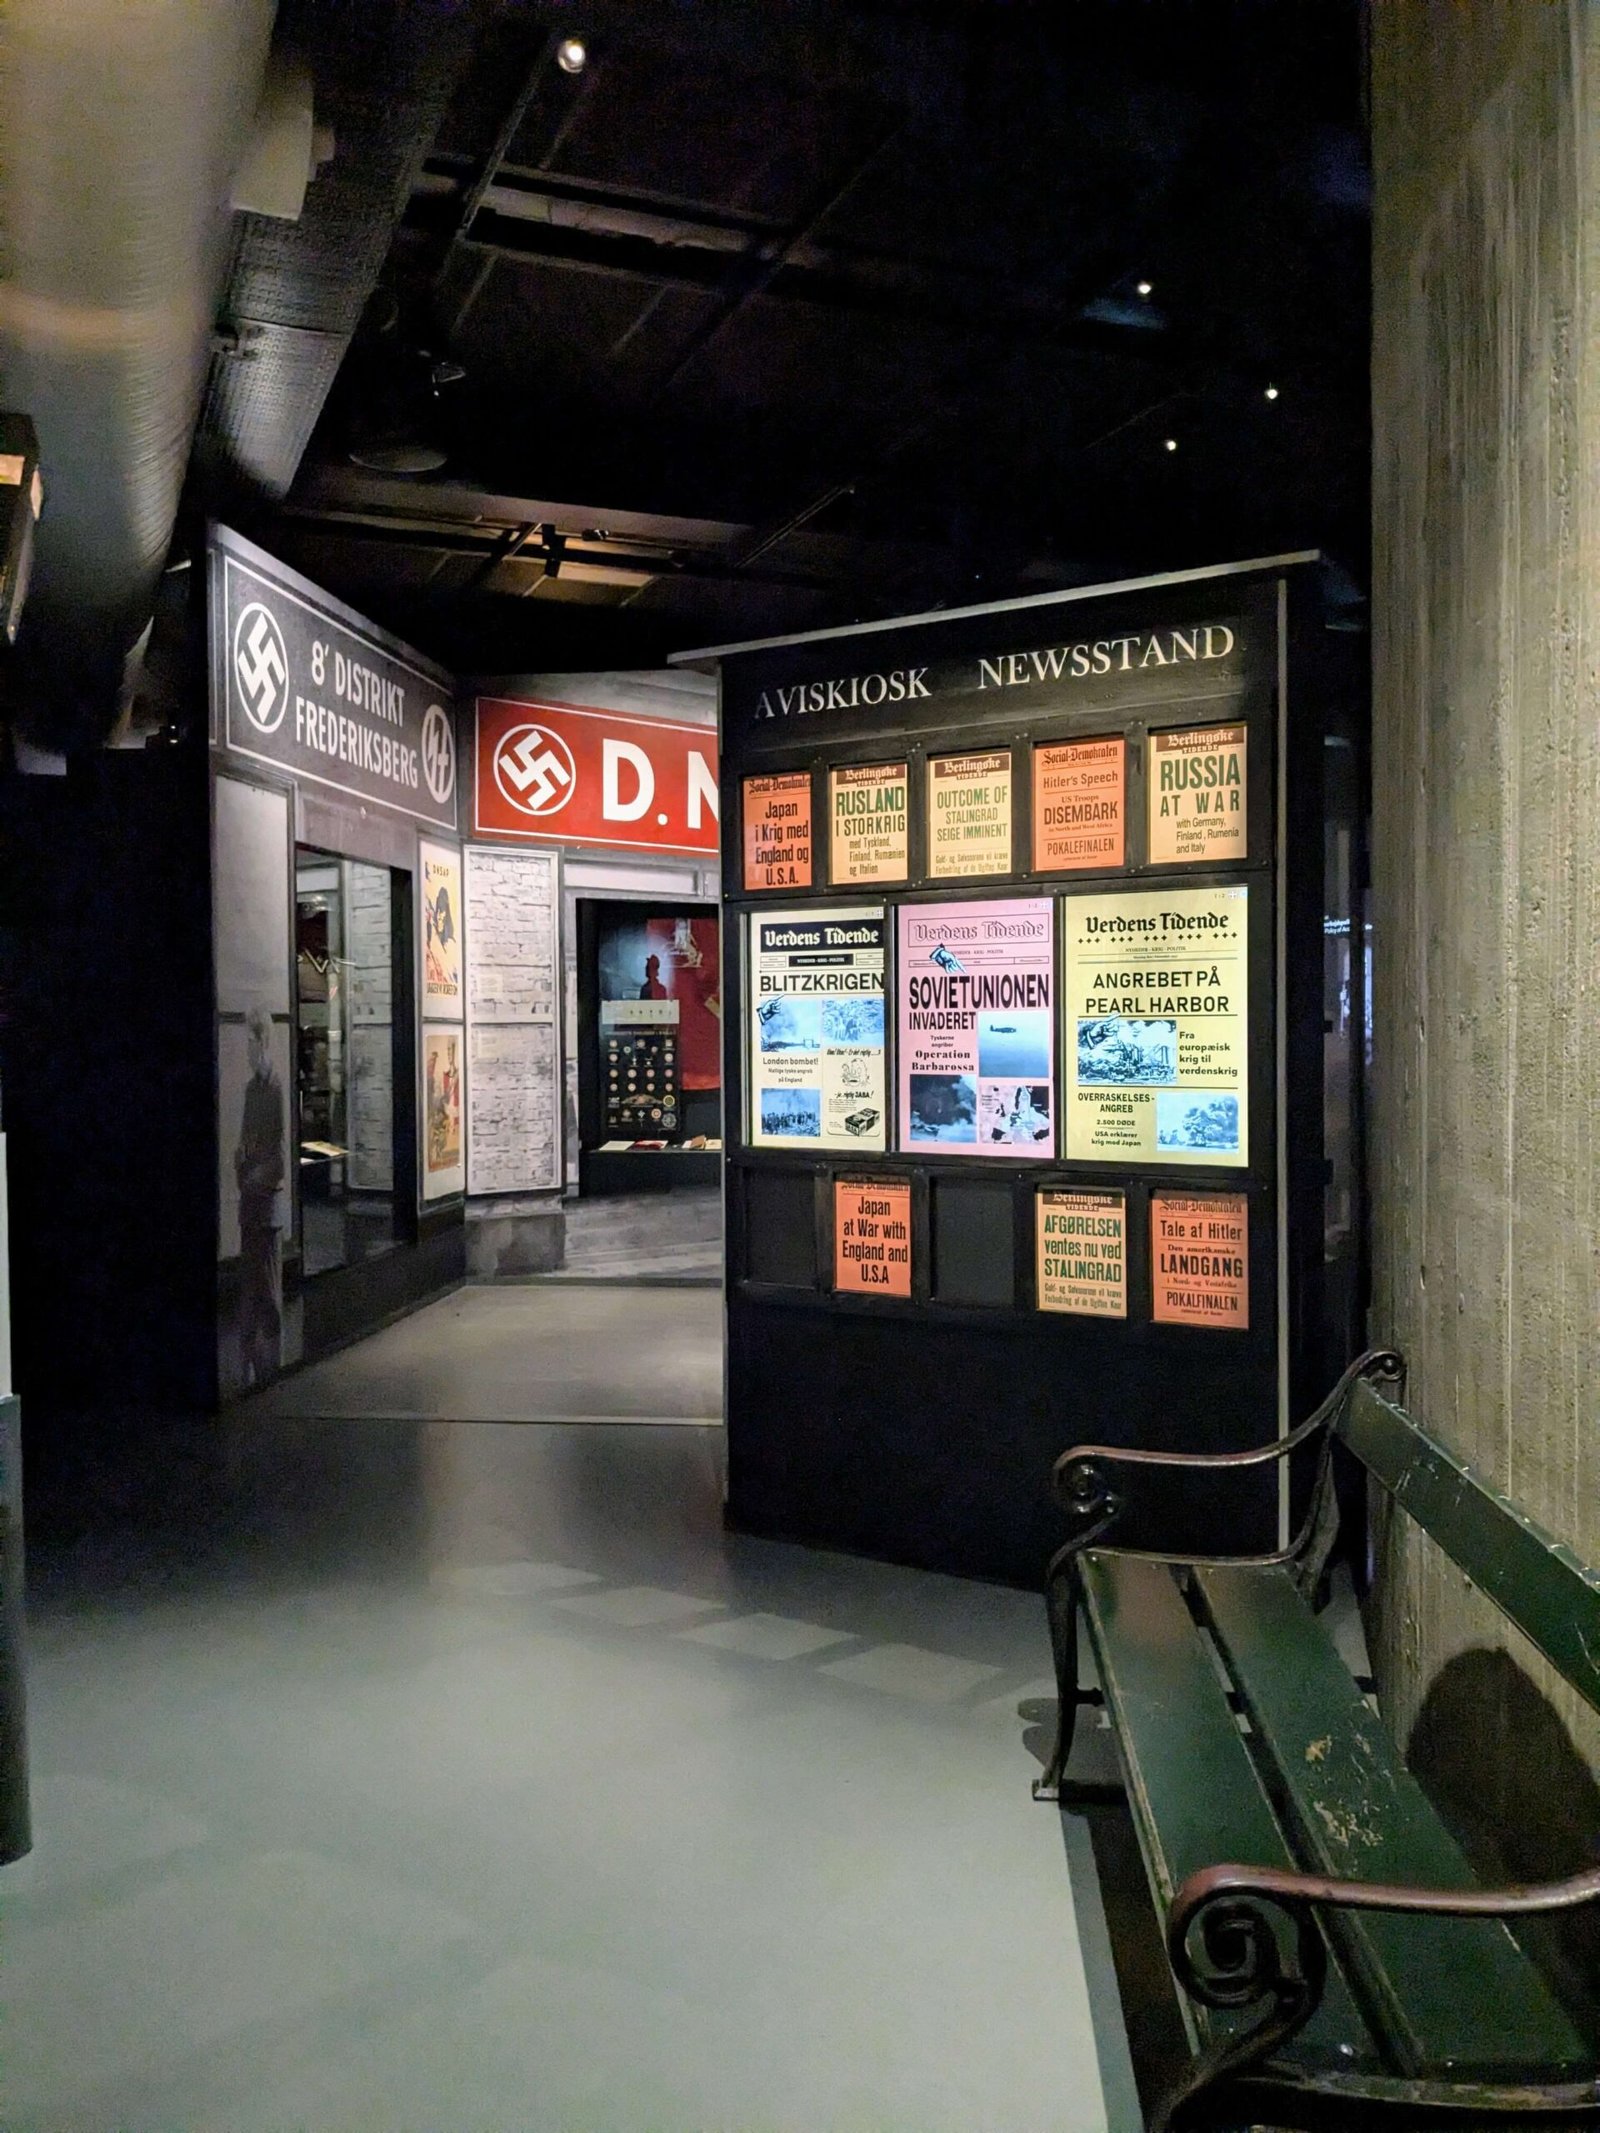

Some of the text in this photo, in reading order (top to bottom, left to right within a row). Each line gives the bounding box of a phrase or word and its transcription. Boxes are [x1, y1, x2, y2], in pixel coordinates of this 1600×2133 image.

[755, 625, 1236, 720] AVISKIOSK NEWSSTAND
[335, 651, 405, 727] DISTRIKT
[296, 695, 418, 789] FREDERIKSBERG
[1168, 729, 1234, 746] Berlingske
[1183, 745, 1218, 754] TIDENDE
[944, 758, 1001, 774] Berlingske
[1160, 754, 1241, 791] RUSSIA
[1044, 770, 1118, 789] Hitler's Speech
[836, 786, 905, 816] RUSLAND
[937, 785, 1008, 809] OUTCOME OF
[1075, 794, 1099, 804] Troops
[1160, 790, 1240, 817] AT WAR
[765, 801, 798, 820] Japan
[946, 808, 998, 824] STALINGRAD
[1044, 801, 1118, 825] DISEMBARK
[762, 824, 783, 842] Krig
[787, 821, 808, 838] med
[844, 814, 905, 836] STORKRIG
[937, 823, 1008, 842] SEIGE IMMINENT
[1176, 817, 1226, 828] with Germany,
[1208, 827, 1239, 839] Rumenia
[850, 839, 861, 849] med
[1047, 838, 1114, 856] POKALEFINALEN
[1176, 842, 1205, 854] and Italy
[756, 844, 808, 866] England og
[850, 864, 878, 877] og Italien
[914, 920, 1044, 942] Verdens Tidende
[1086, 911, 1229, 934] Verdens Tidende
[764, 927, 879, 947] Verdens Tidende
[760, 972, 884, 992] BLITZKRIGEN
[1093, 966, 1221, 989] ANGREBET PÅ
[909, 974, 1049, 1009] SOVIETUNIONEN
[1086, 996, 1229, 1013] PEARL HARBOR
[909, 1012, 976, 1030] INVADERET
[1179, 1031, 1194, 1040] Fra
[916, 1050, 971, 1060] Operation
[1179, 1043, 1231, 1052] europæisk
[912, 1062, 974, 1071] Barbarossa
[1179, 1055, 1211, 1064] krig til
[1179, 1067, 1238, 1077] verdenskrig
[1100, 1104, 1133, 1113] ANGREB
[858, 1196, 890, 1218] Japan
[844, 1219, 906, 1239] at War with
[1044, 1215, 1121, 1238] AFGØRELSEN
[1160, 1220, 1242, 1240] Tale af Hitler
[842, 1240, 908, 1262] England and
[1045, 1238, 1121, 1259] ventes nu ved
[1045, 1258, 1121, 1282] STALINGRAD
[1161, 1253, 1243, 1278] LANDGANG
[1166, 1291, 1238, 1311] POKALFINALEN
